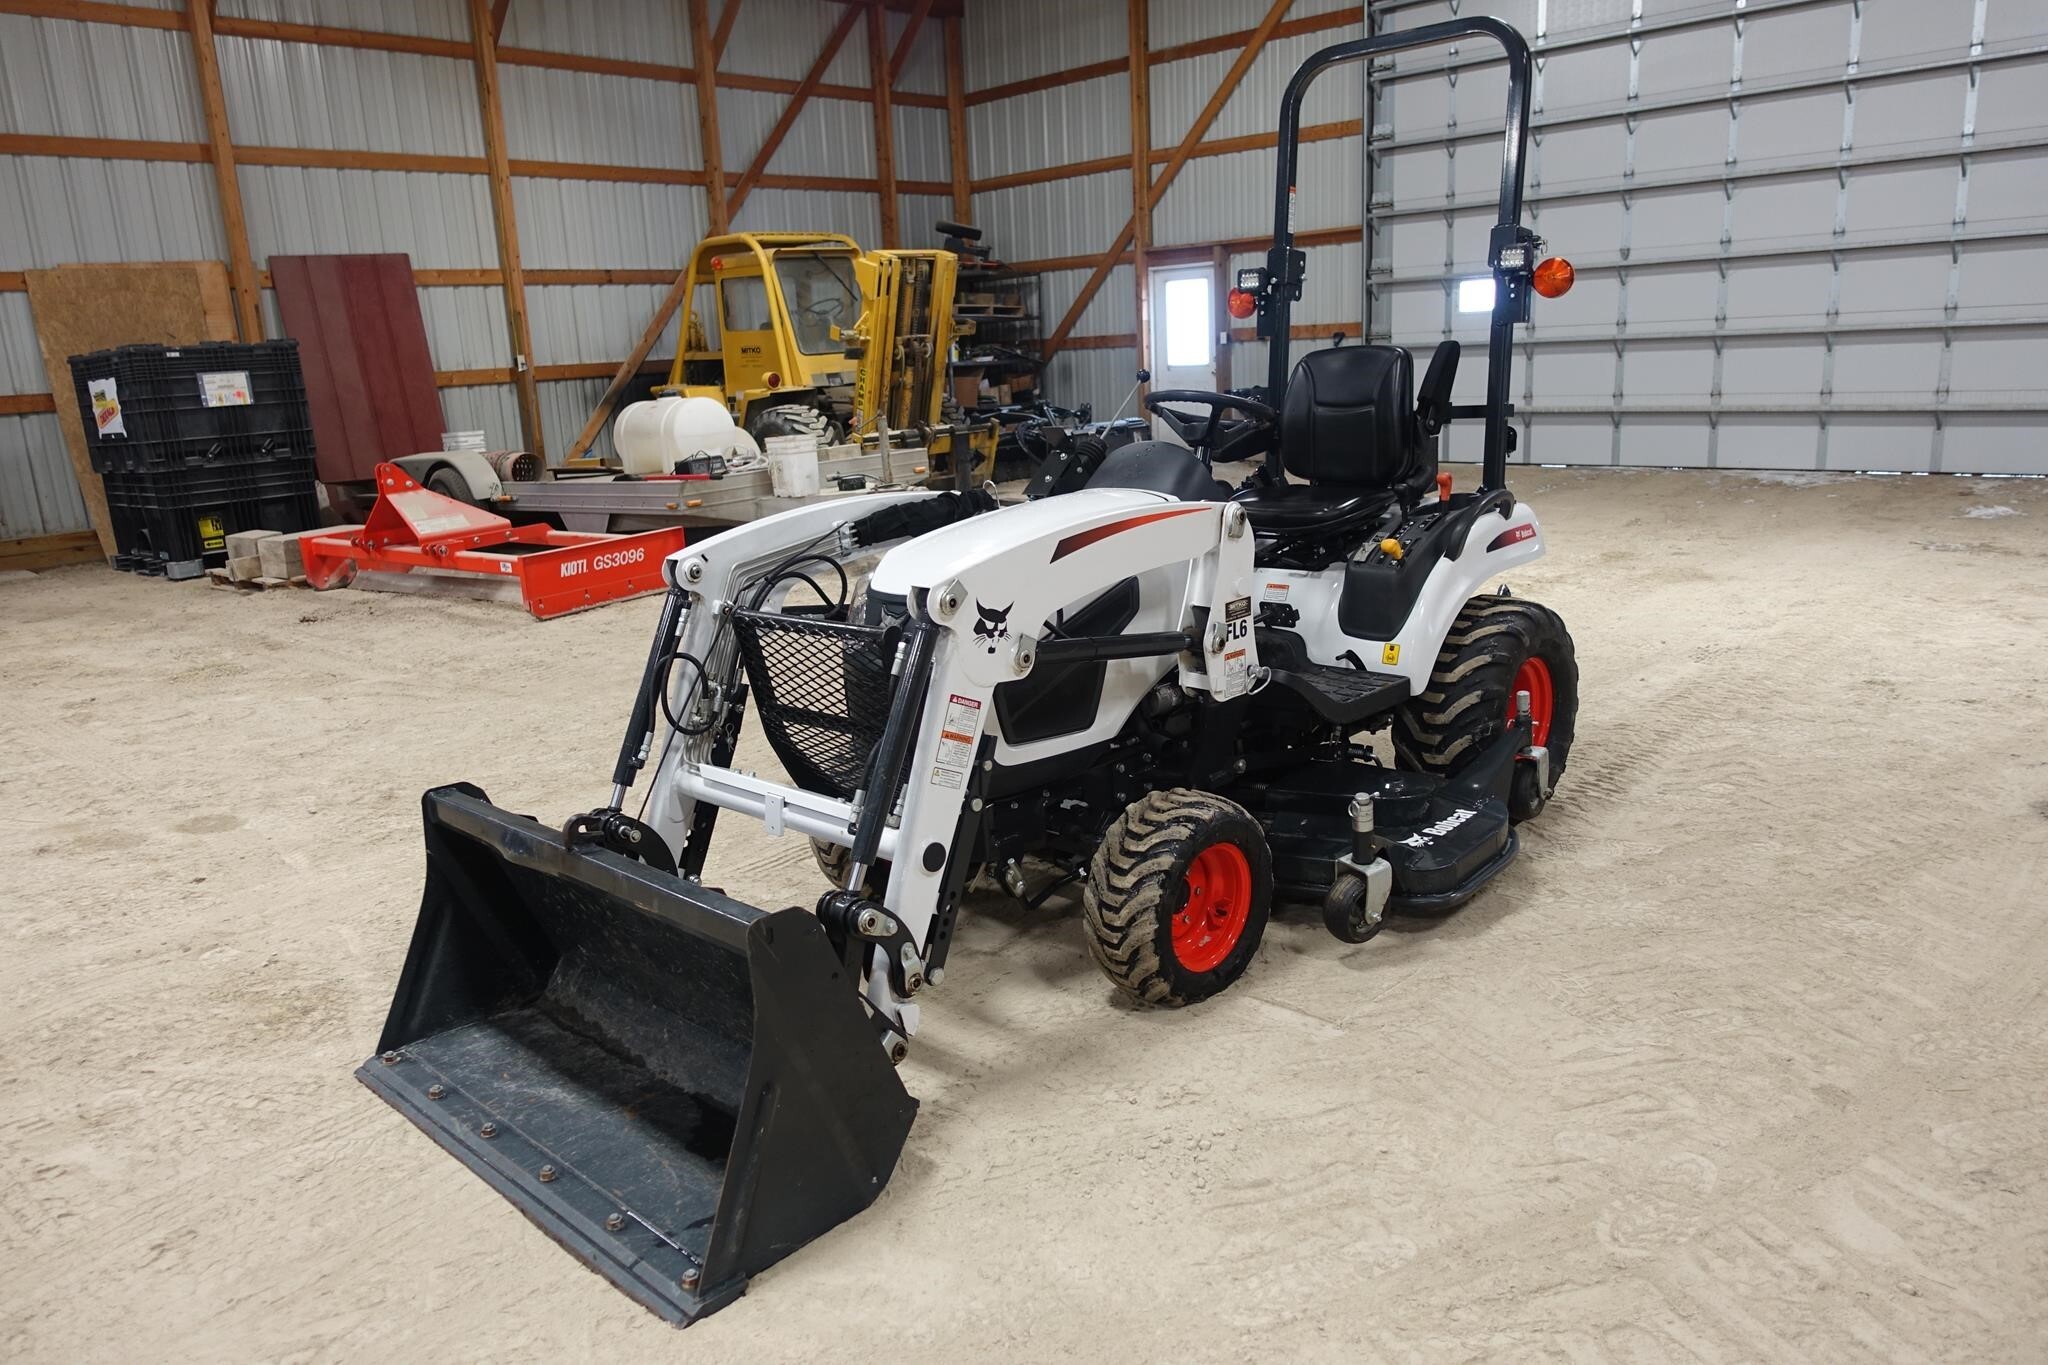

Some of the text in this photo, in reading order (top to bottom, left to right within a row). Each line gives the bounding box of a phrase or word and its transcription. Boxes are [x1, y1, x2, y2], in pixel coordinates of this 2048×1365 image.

[741, 346, 761, 354] MITKO
[560, 547, 645, 578] KIOTI GS3096
[1226, 619, 1248, 643] FL6
[957, 697, 979, 709] DANGER
[1421, 808, 1478, 837] Bobcat
